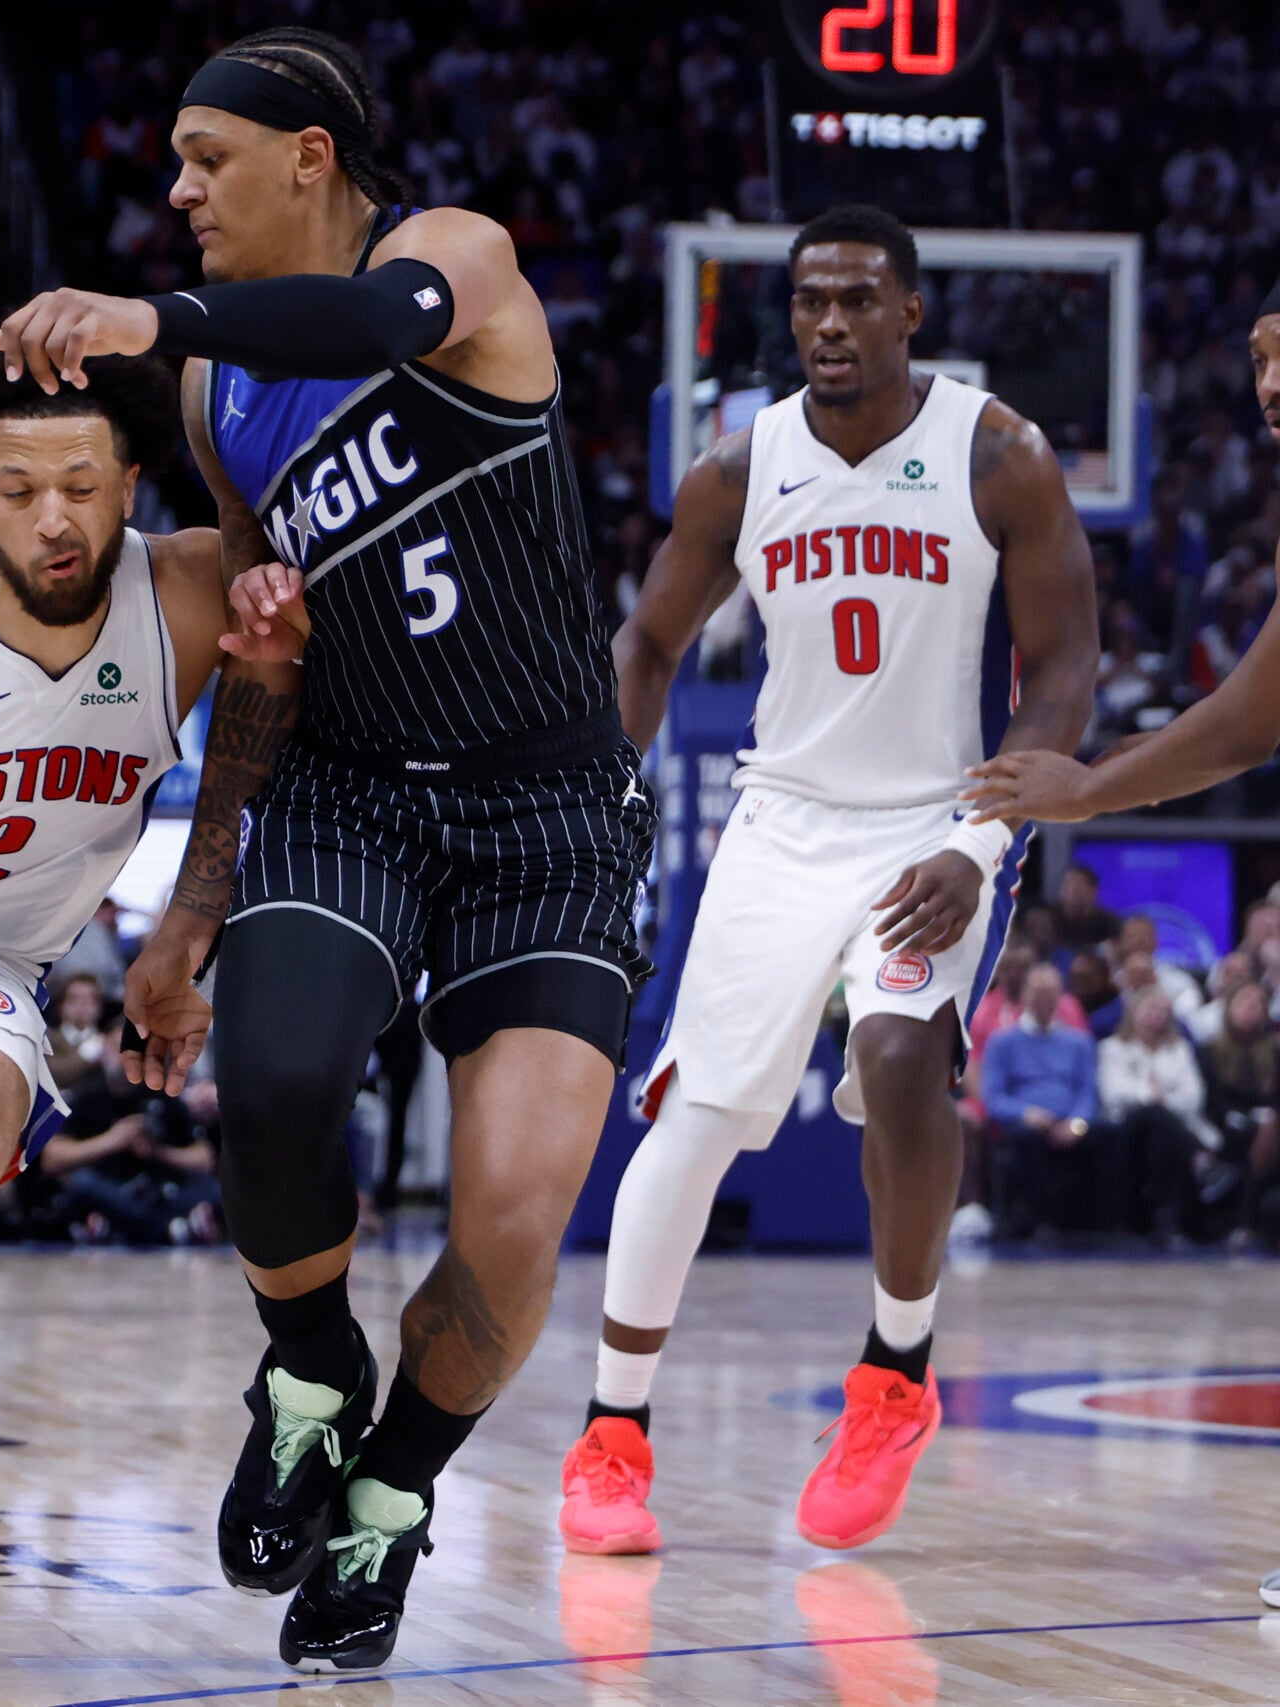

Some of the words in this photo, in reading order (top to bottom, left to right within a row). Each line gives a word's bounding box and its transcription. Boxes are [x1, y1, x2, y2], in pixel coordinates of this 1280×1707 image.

[821, 0, 958, 75] 20
[885, 479, 939, 492] StockX
[399, 530, 461, 638] 5
[761, 524, 951, 593] PISTONS
[831, 596, 881, 675] 0
[80, 690, 139, 706] StockX
